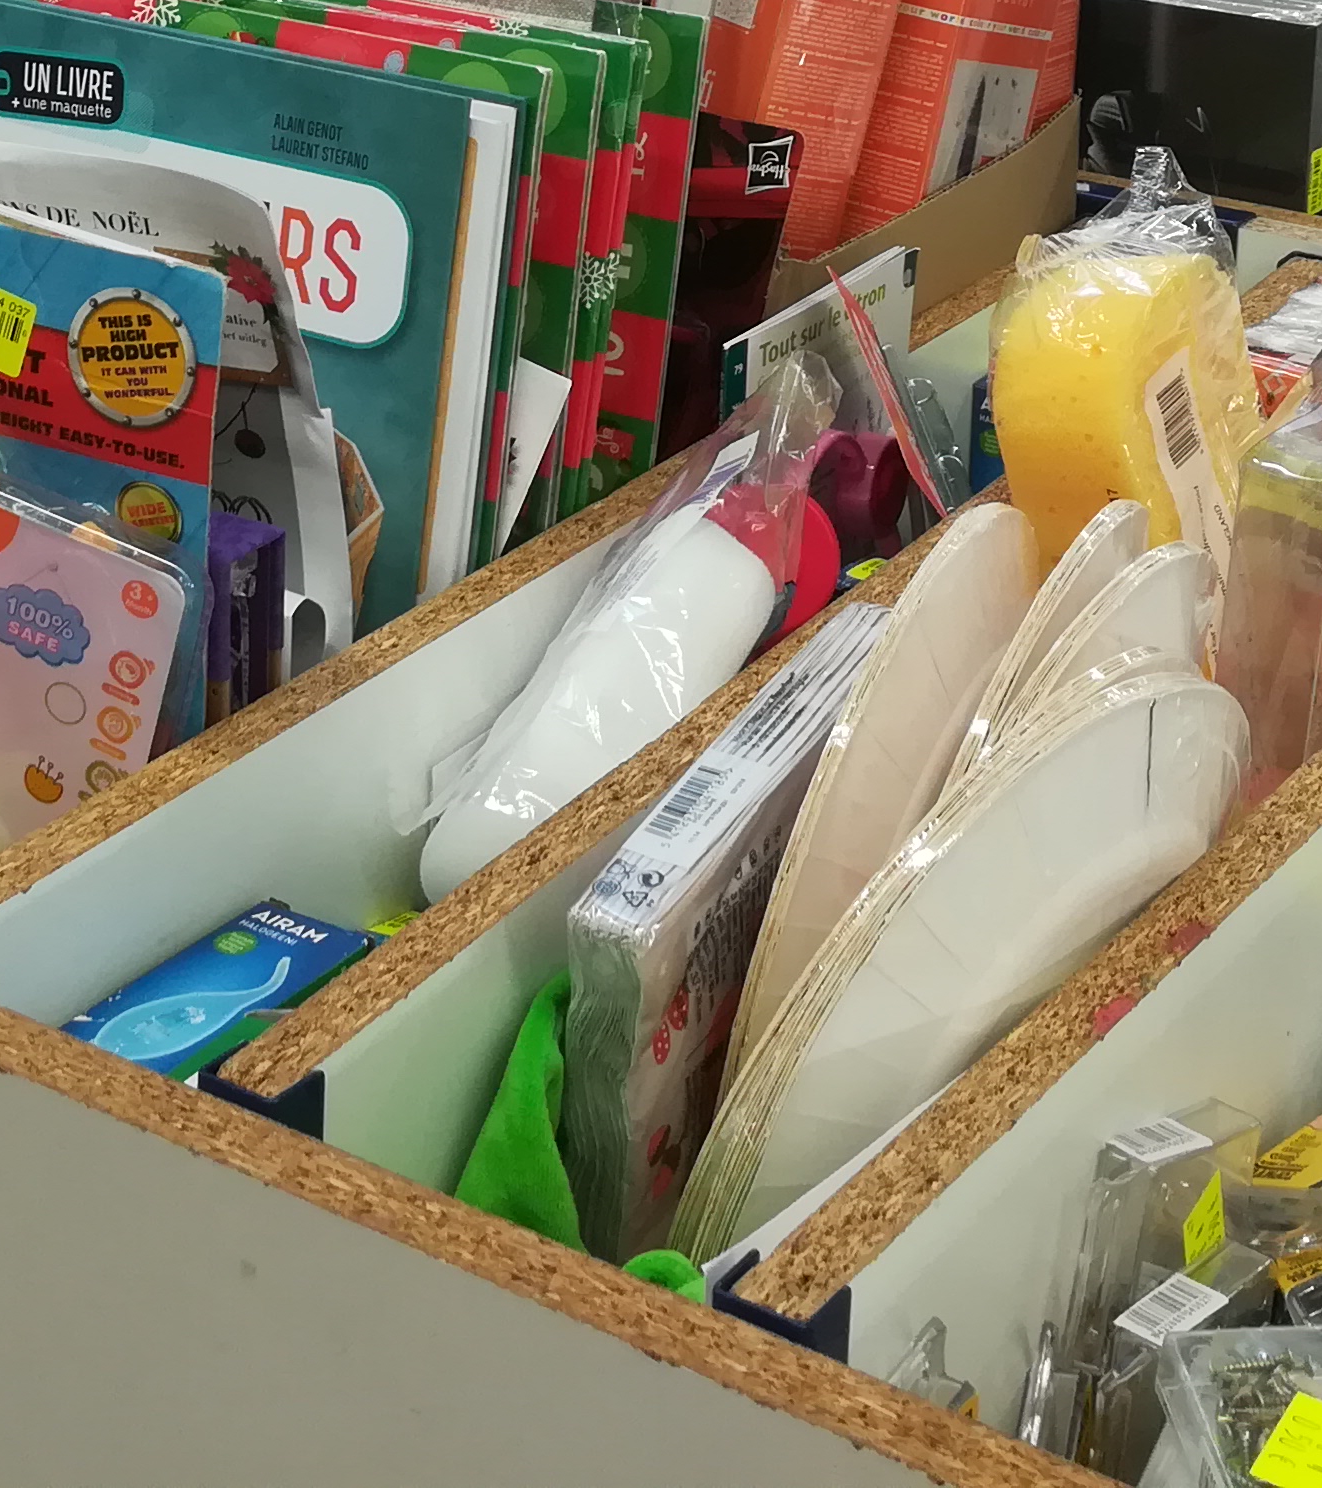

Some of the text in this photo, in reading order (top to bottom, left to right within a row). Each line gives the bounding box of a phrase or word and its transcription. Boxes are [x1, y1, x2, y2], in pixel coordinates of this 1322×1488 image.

[23, 62, 113, 102] UN LIVRE
[23, 97, 112, 118] une maquette
[273, 114, 343, 142] ALAIN GENOT
[272, 135, 369, 170] LAURENT STEFANO
[47, 205, 160, 237] DE NOËL
[9, 301, 31, 317] 037
[98, 314, 152, 329] THIS IS
[110, 328, 147, 342] HIGH
[759, 303, 841, 367] Tout sur le
[82, 342, 179, 363] PRODUCT
[101, 365, 167, 376] IT CAN WITH
[127, 376, 148, 387] YOU
[104, 387, 175, 399] WONDERFUL.
[59, 427, 185, 469] EASY-TO-USE.
[128, 502, 165, 517] WIDE
[5, 597, 74, 640] 100%
[7, 620, 59, 653] SAFE
[238, 919, 298, 946] HALOGEENI
[251, 910, 329, 944] AIRAM
